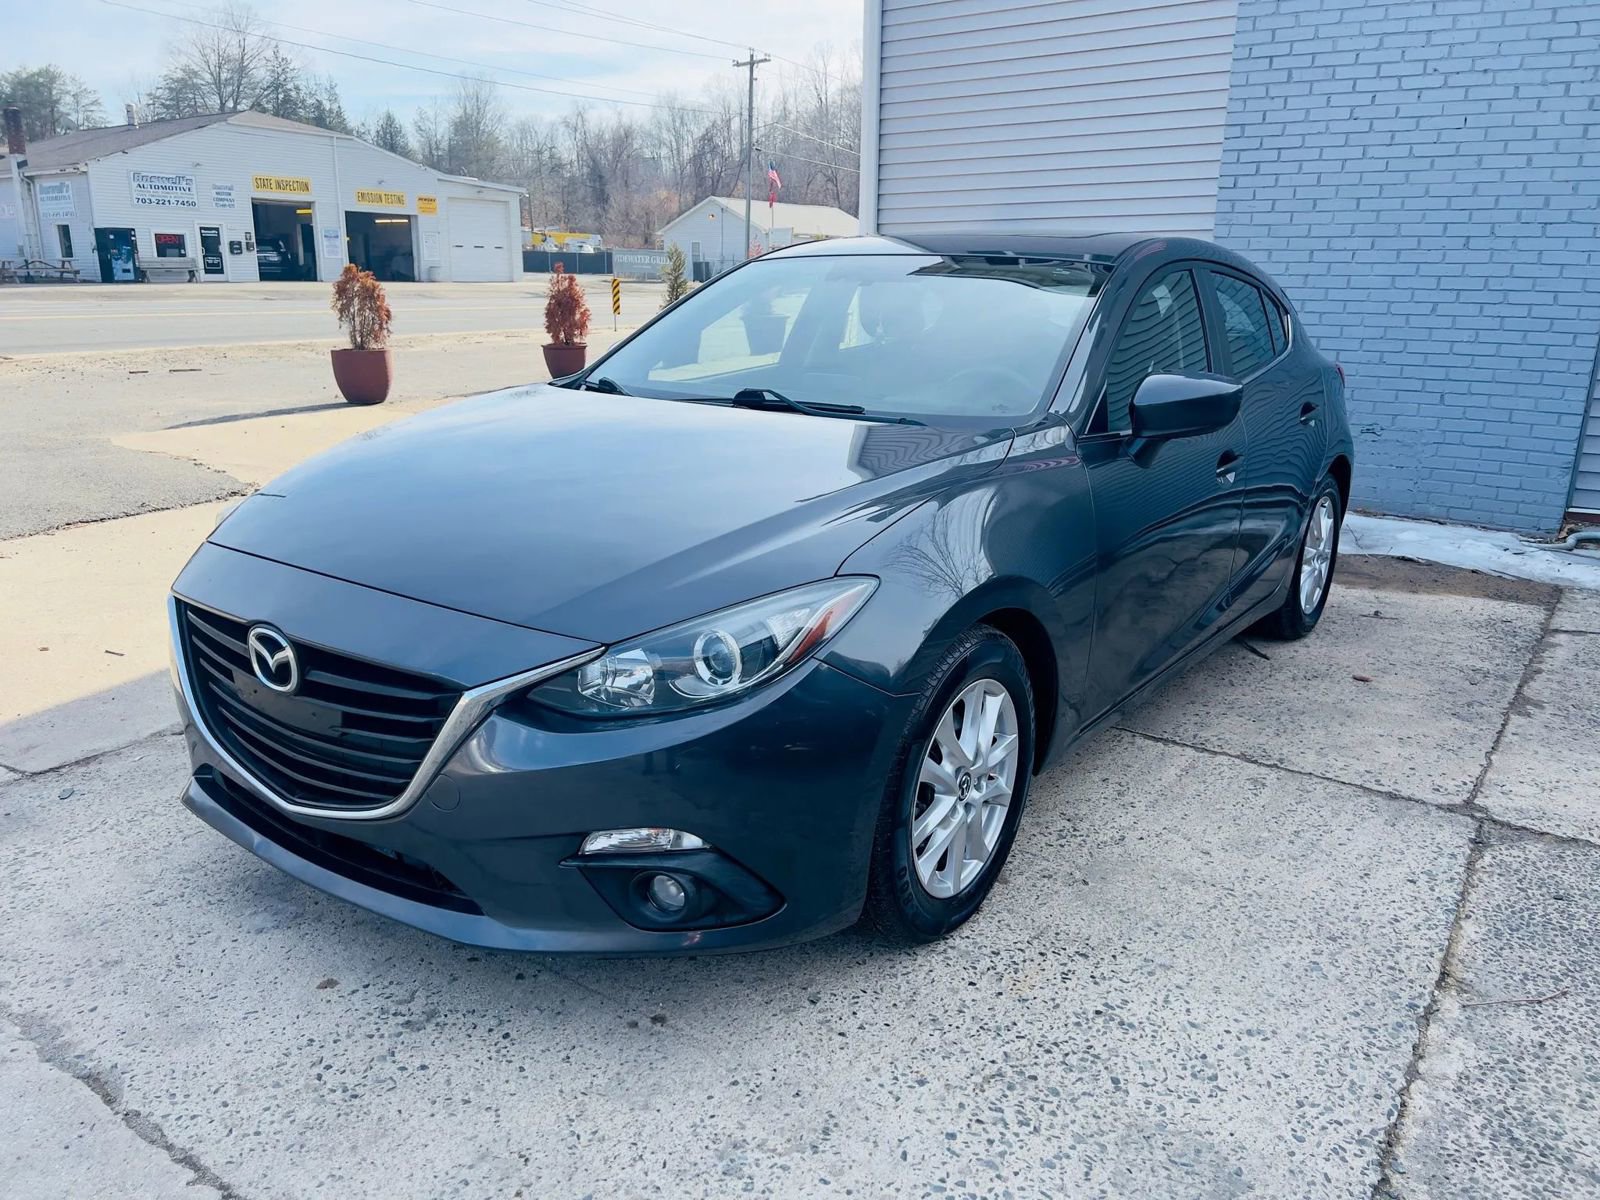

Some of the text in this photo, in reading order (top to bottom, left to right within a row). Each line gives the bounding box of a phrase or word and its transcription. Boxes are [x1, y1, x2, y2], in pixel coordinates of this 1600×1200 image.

[135, 183, 194, 193] AUTOMOTIVE
[255, 177, 310, 193] STATE INSPECTION
[135, 197, 197, 207] 703-221-7450
[357, 191, 405, 205] EMISSION TESTING
